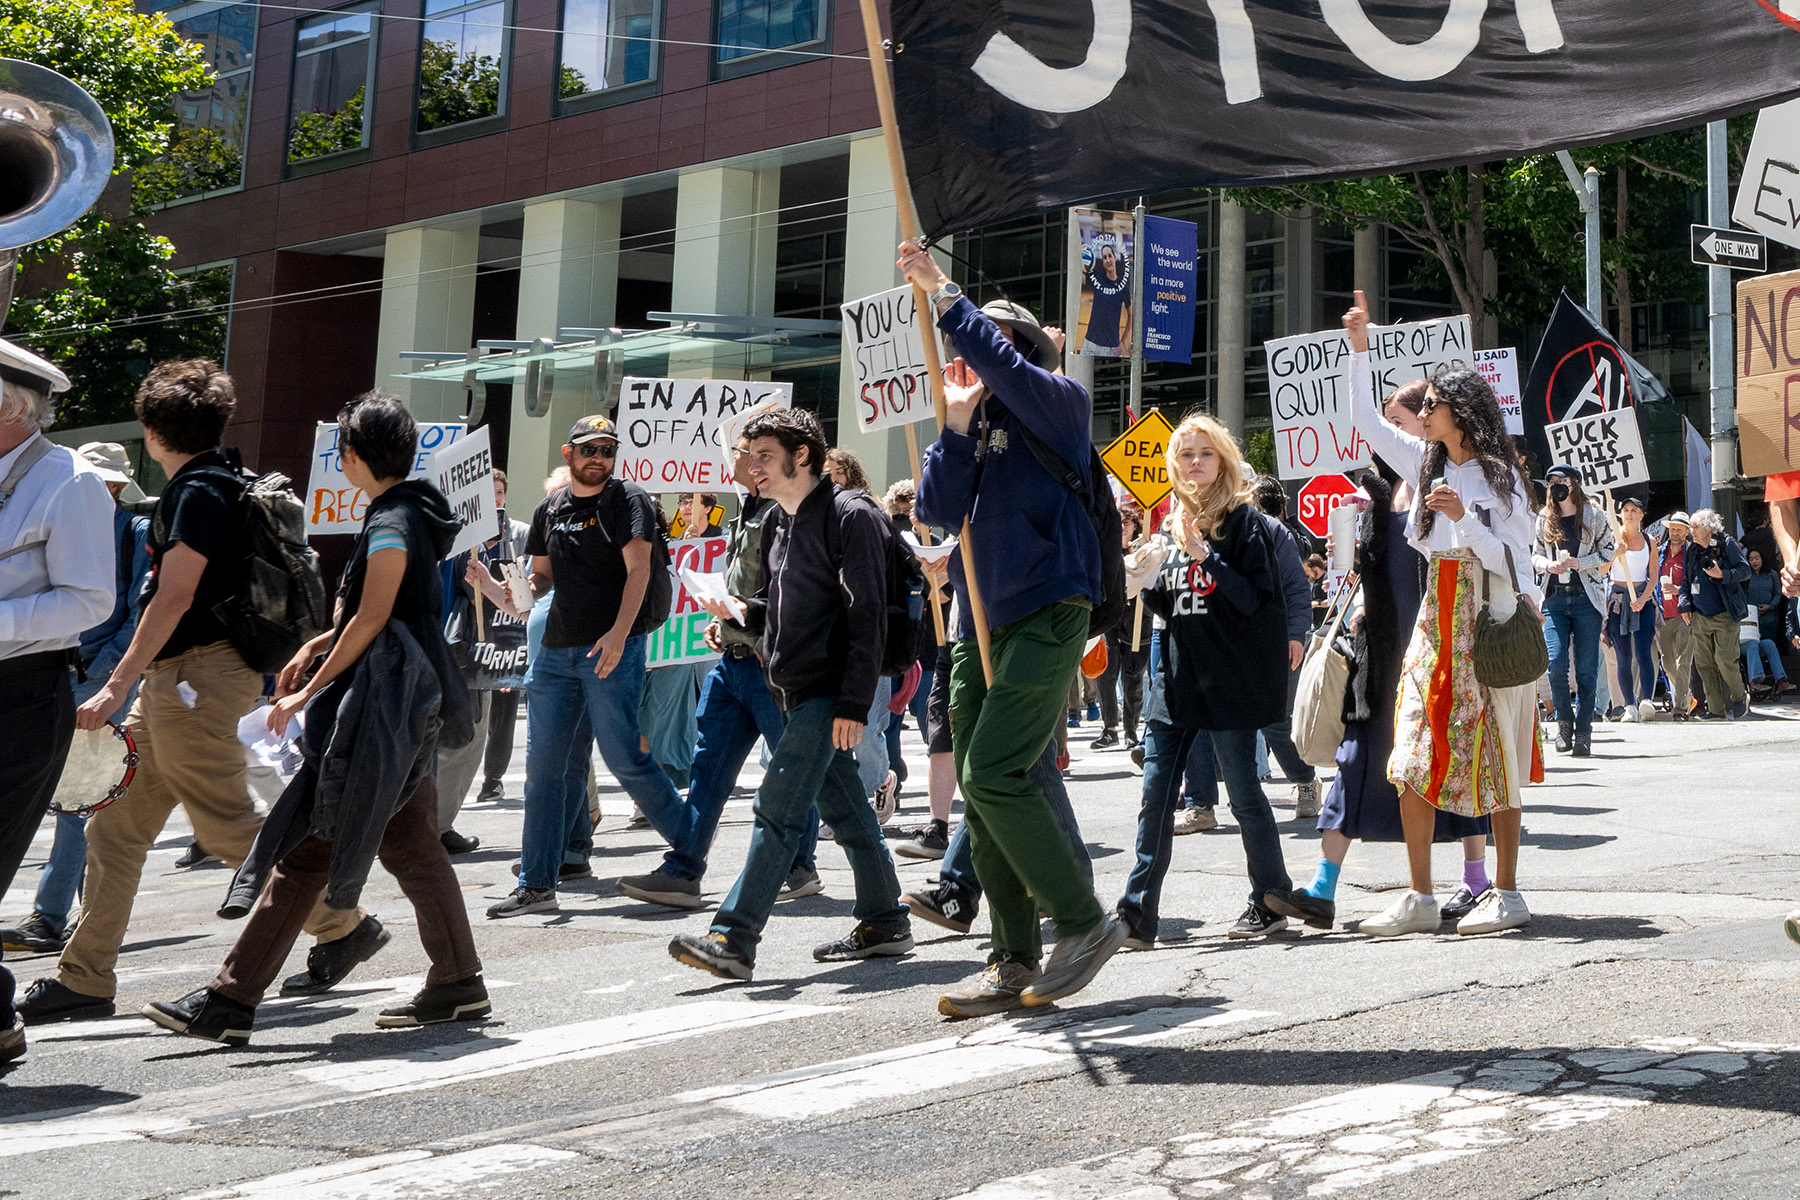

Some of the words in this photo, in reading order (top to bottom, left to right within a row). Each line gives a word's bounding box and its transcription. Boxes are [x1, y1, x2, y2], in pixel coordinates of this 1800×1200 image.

[1150, 242, 1164, 255] We
[1165, 248, 1179, 258] see
[1157, 256, 1171, 268] the
[1171, 260, 1193, 271] world
[1714, 240, 1733, 255] ONE
[1737, 243, 1757, 258] WAY
[1150, 273, 1158, 285] in
[1158, 277, 1164, 286] a
[1164, 278, 1184, 289] more
[1151, 301, 1170, 315] light.
[1156, 290, 1187, 303] positive
[846, 297, 893, 344] YOU
[856, 332, 926, 382] STILL
[1271, 329, 1407, 378] GODFAHER
[1411, 323, 1437, 357] OF
[1441, 320, 1467, 352] AI
[1484, 350, 1509, 361] SAID
[628, 381, 675, 411] IN
[685, 384, 710, 418] A
[860, 373, 917, 425] STOP
[1275, 374, 1342, 421] QUIT
[629, 418, 688, 448] OFF
[690, 421, 707, 447] A
[1276, 426, 1320, 469] TO
[1551, 416, 1620, 451] FUCK
[1558, 439, 1618, 466] THIS
[439, 471, 450, 497] AI
[451, 447, 491, 493] FREEZE
[622, 457, 653, 484] NO
[661, 460, 713, 485] ONE
[1581, 453, 1634, 487] HIT
[474, 642, 530, 671] TORME
